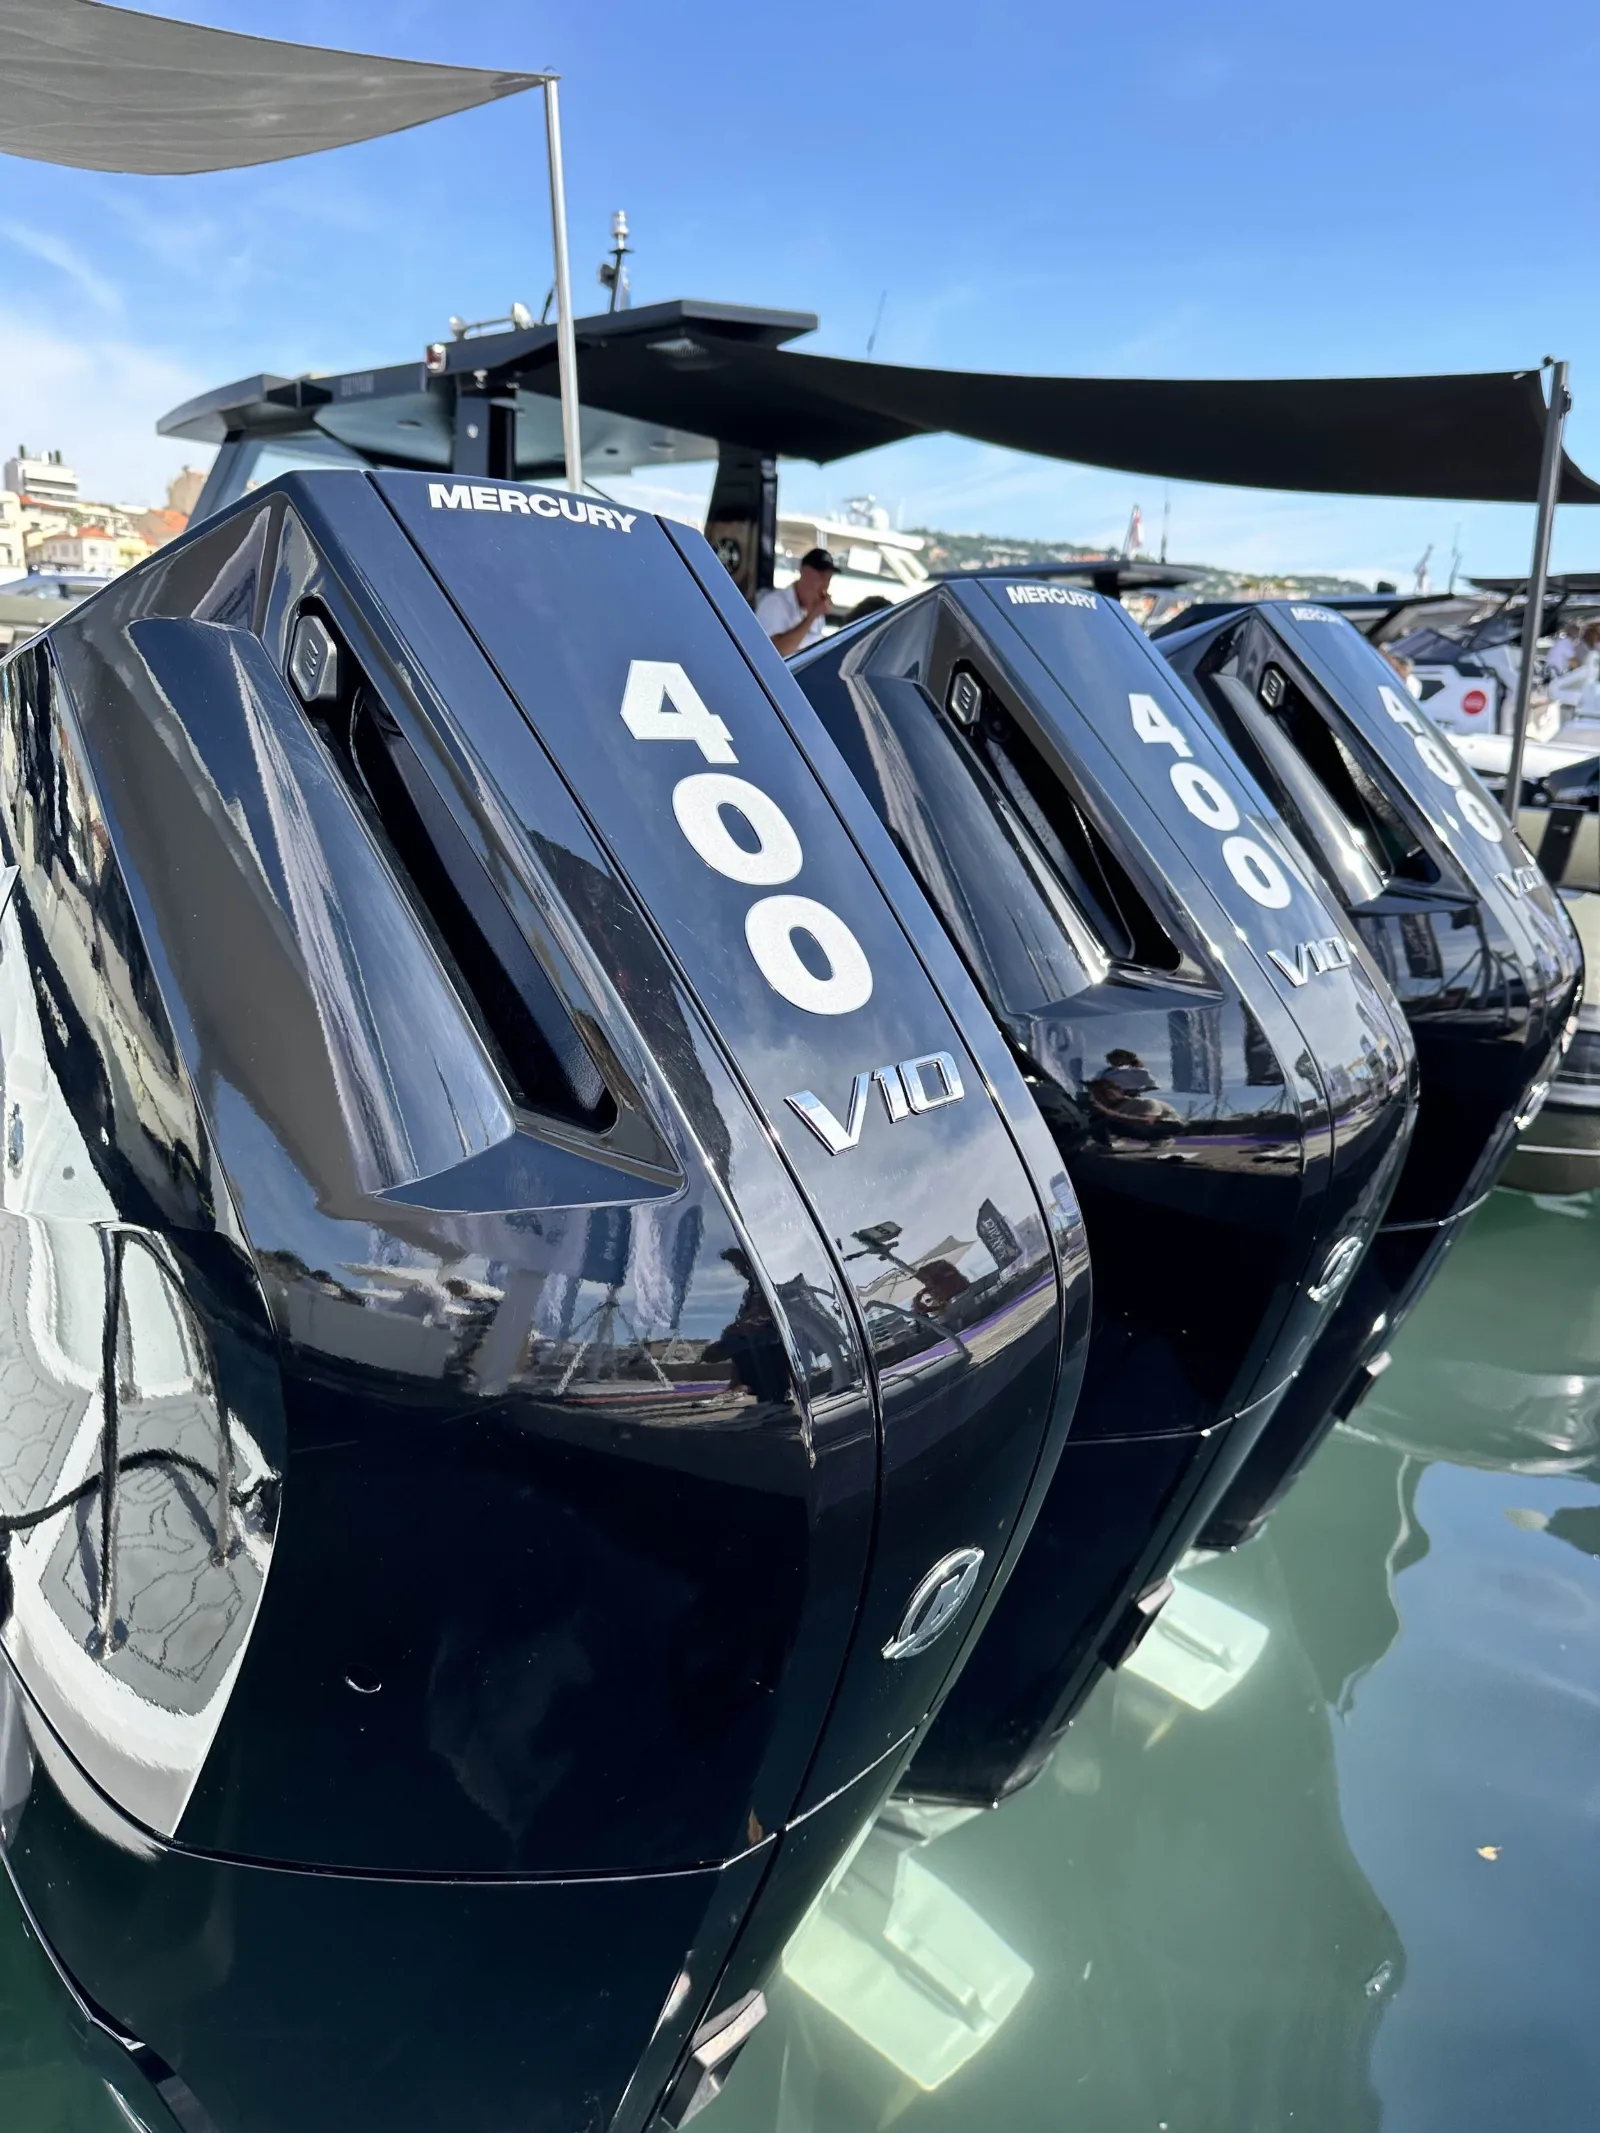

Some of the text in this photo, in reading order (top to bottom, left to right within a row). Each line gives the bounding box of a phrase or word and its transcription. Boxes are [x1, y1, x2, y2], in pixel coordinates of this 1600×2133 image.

[428, 483, 637, 533] MERCURY
[1006, 586, 1097, 610] MERCURY
[1129, 693, 1292, 909] 400
[1376, 686, 1502, 842] 400
[620, 659, 873, 1015] 400
[1265, 936, 1351, 987] V10
[785, 1051, 964, 1156] V10
